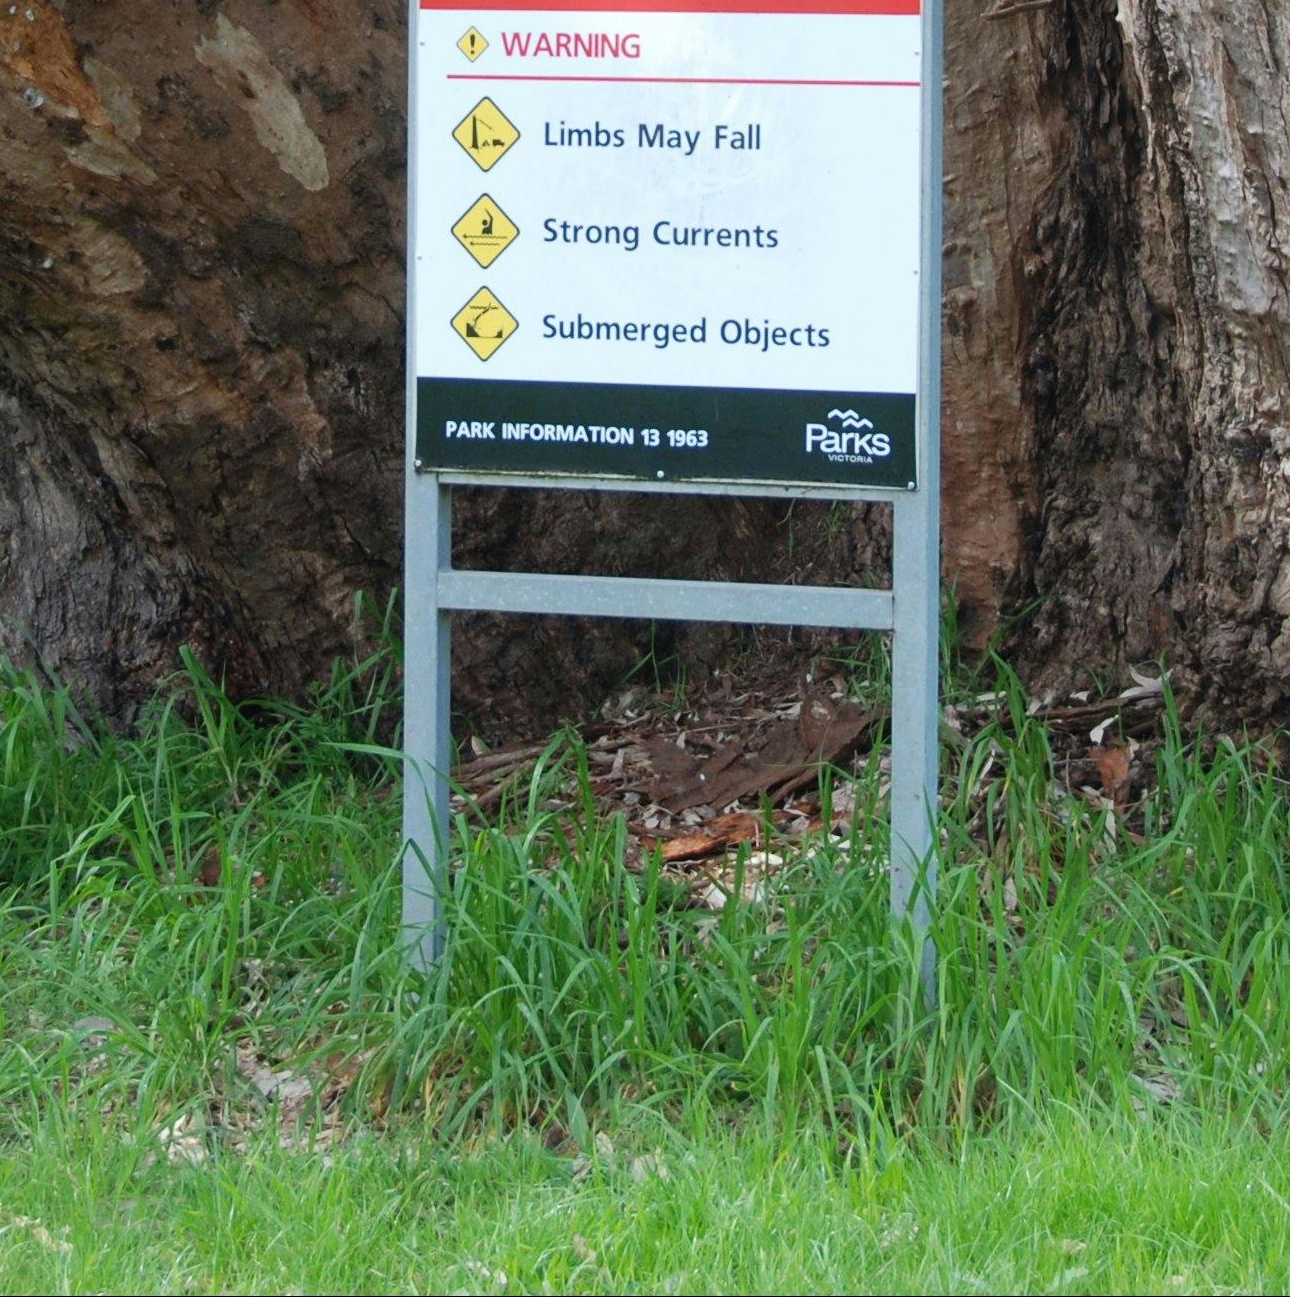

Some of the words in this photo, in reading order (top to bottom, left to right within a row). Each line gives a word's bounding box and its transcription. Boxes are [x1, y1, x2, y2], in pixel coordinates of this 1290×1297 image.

[501, 33, 640, 59] WARNING
[545, 121, 624, 147] Limbs
[639, 124, 700, 155] May
[716, 124, 760, 149] Fall
[544, 218, 639, 251] Strong
[653, 221, 778, 247] Currents
[543, 314, 706, 348] Submerged
[721, 319, 829, 352] Objects
[446, 421, 495, 438] PARK
[502, 423, 634, 444] INFORMATION
[641, 429, 659, 446] 13
[667, 430, 708, 446] 1963
[806, 423, 891, 456] Parks
[827, 454, 873, 464] VICTORIA
